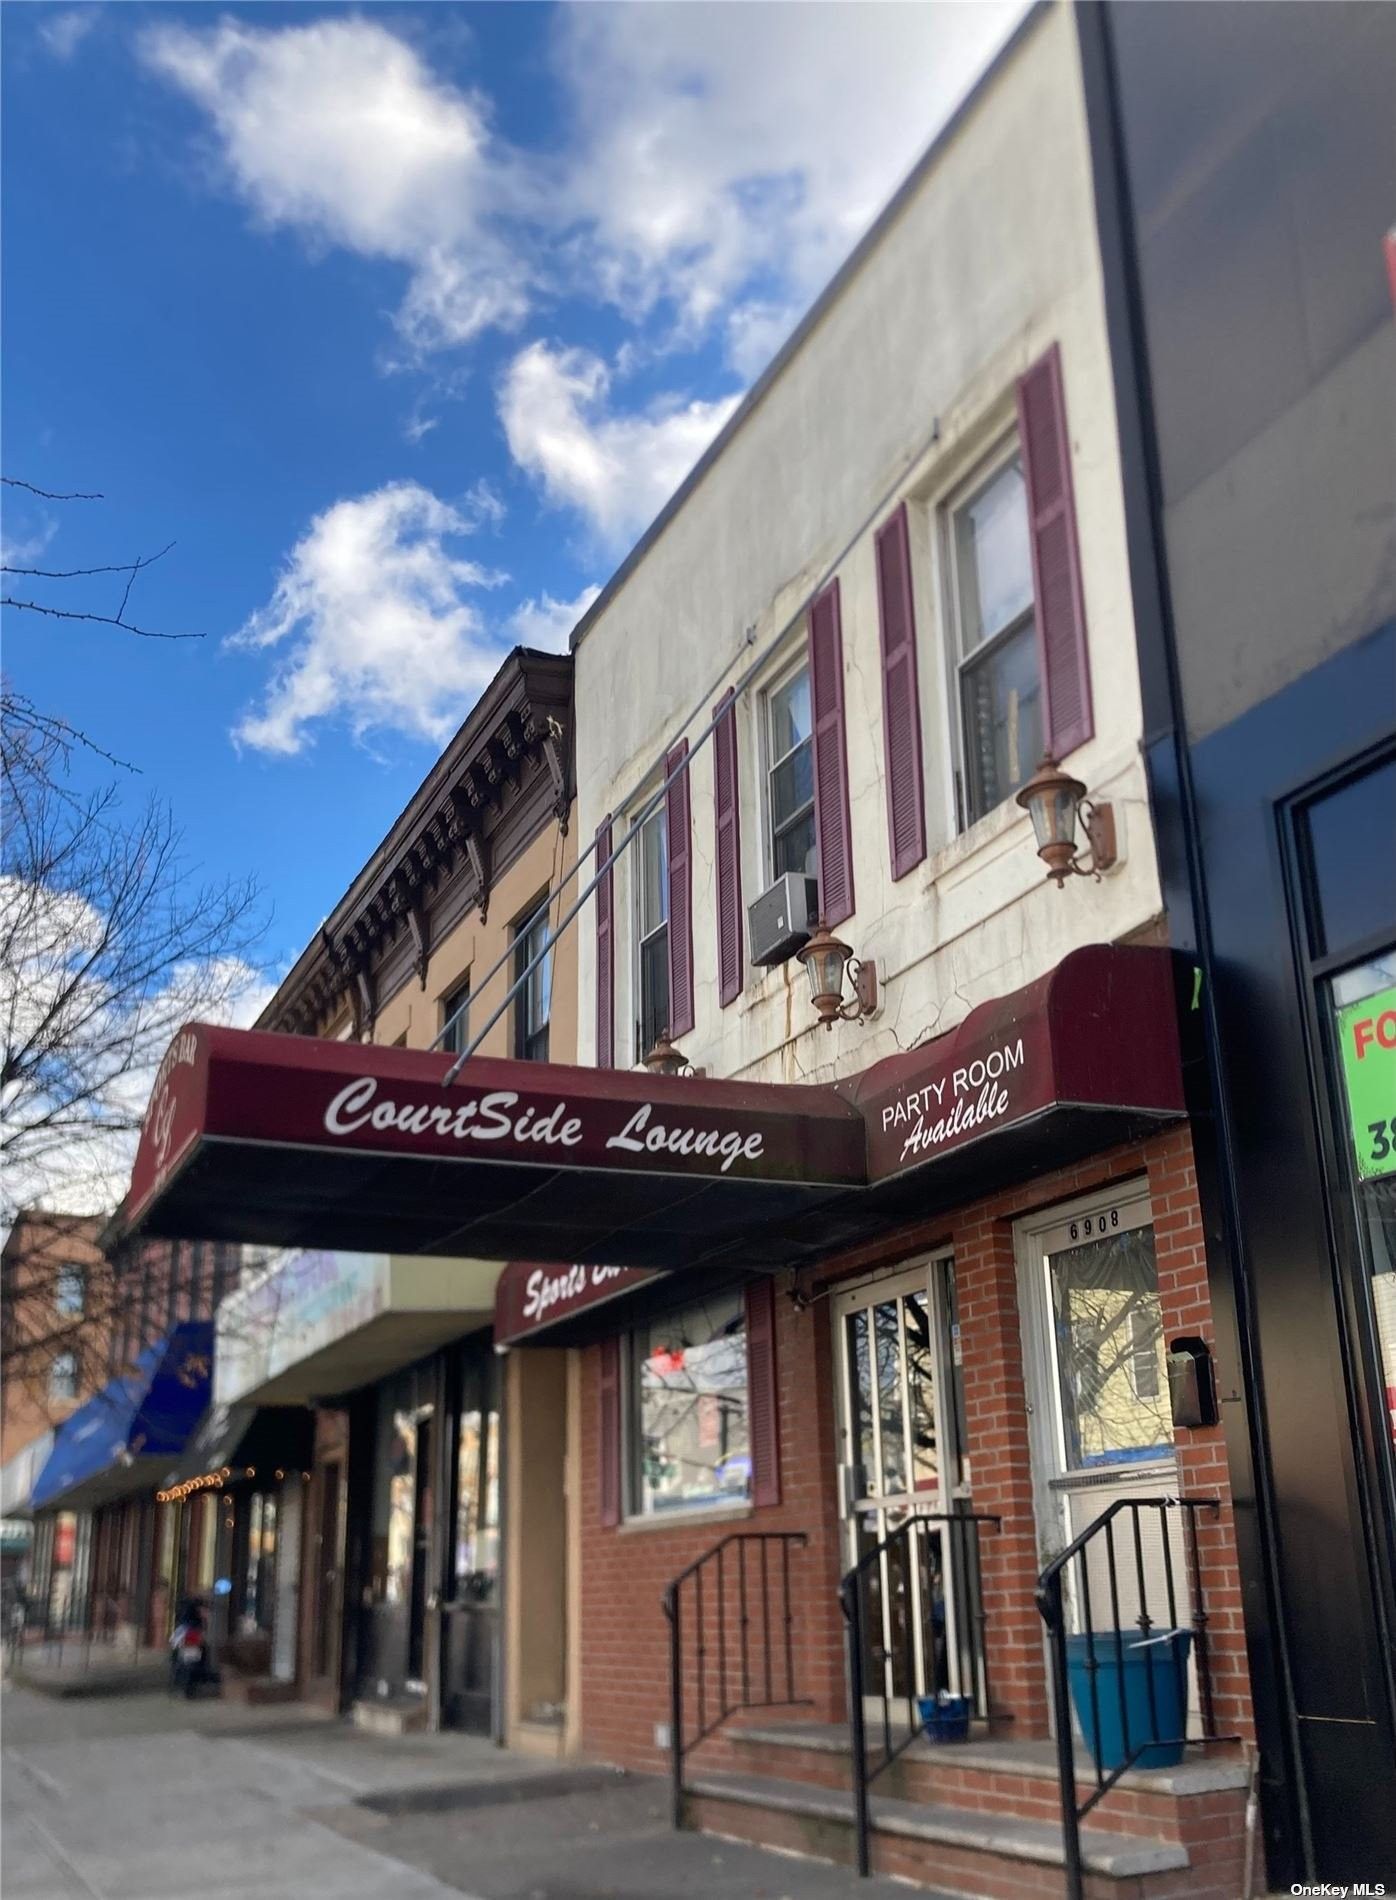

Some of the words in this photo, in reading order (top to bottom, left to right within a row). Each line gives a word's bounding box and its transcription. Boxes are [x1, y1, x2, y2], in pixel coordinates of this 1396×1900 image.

[178, 1032, 198, 1066] BAR
[881, 1077, 946, 1132] PARTY
[952, 1038, 1025, 1097] ROOM
[323, 1077, 583, 1146] CourtSide
[605, 1103, 764, 1173] Lounge
[900, 1081, 1009, 1162] Available
[1070, 1210, 1119, 1239] 6908
[522, 1264, 587, 1322] Sports
